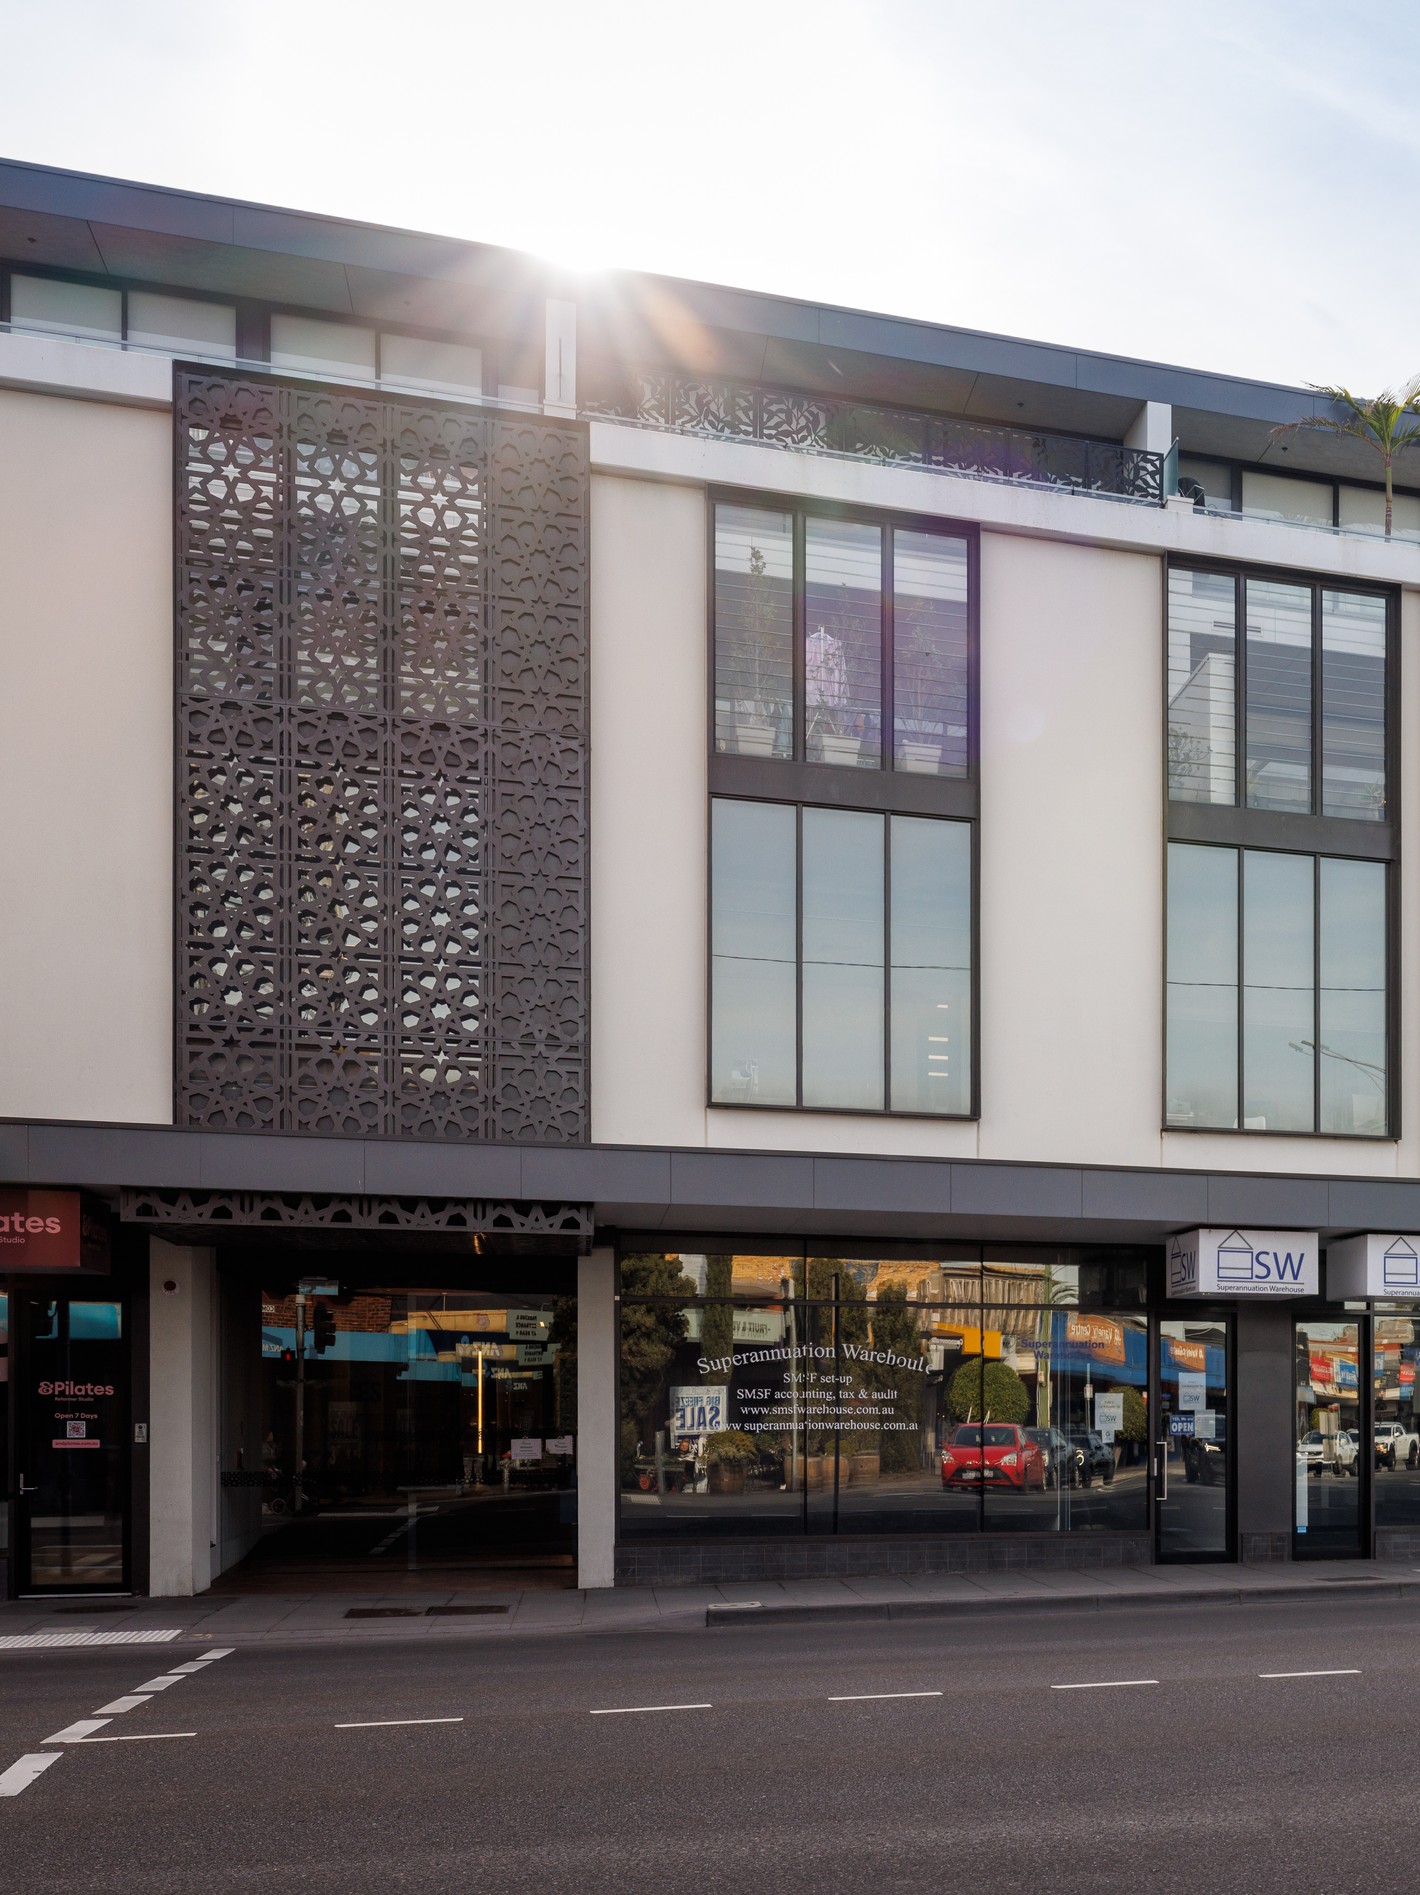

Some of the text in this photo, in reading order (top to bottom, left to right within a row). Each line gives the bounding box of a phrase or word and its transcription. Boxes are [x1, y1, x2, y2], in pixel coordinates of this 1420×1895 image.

[1181, 1250, 1196, 1282] SW
[1254, 1250, 1305, 1281] SW
[1216, 1283, 1305, 1294] Superannuation Warehouse
[1021, 1339, 1105, 1350] Superannuation
[697, 1342, 837, 1375] Superannuation
[1033, 1350, 1093, 1360] Warehouse
[783, 1372, 853, 1385] SMF set-up
[38, 1380, 115, 1396] &Pilates
[736, 1388, 898, 1401] SMSF accounting, tax & audit
[740, 1403, 895, 1415] www.smsfwarehouse.com.au
[54, 1412, 74, 1420] Open
[80, 1412, 98, 1420] Days
[1171, 1422, 1194, 1432] OPEN
